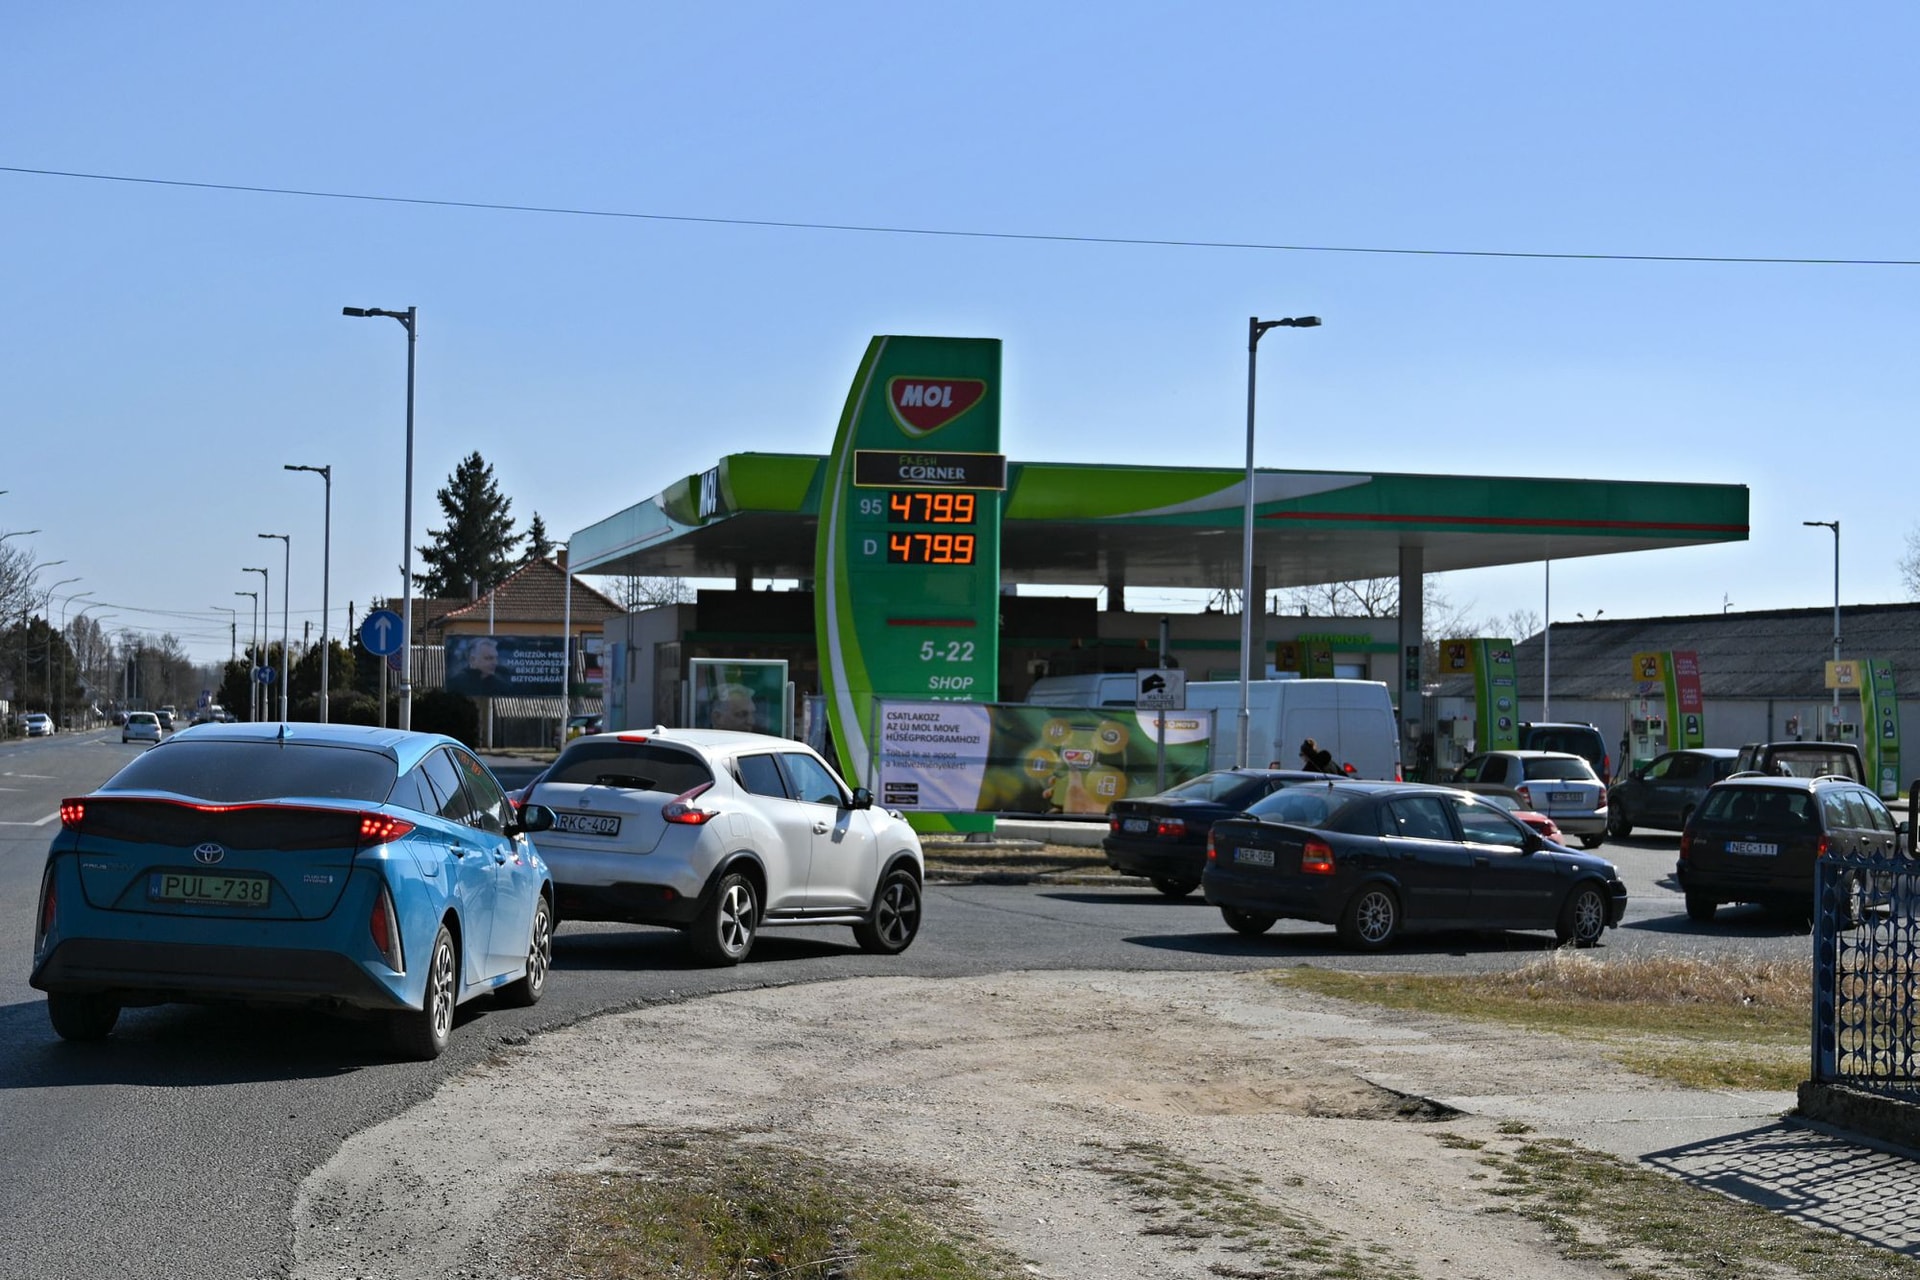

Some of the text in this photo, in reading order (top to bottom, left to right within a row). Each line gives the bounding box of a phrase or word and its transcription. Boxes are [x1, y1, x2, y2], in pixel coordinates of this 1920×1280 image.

[901, 385, 953, 408] MOL
[899, 455, 937, 465] FRESH
[899, 466, 965, 479] CORNER
[860, 499, 882, 514] 95
[863, 539, 877, 555] D
[920, 641, 975, 661] 5-22
[928, 676, 974, 690] SHOP
[886, 712, 940, 722] CSATLAKOZZ
[886, 722, 960, 733] AZ ÚJ MOL MOVE
[559, 815, 616, 832] RKC-402
[1731, 843, 1775, 853] NEC-111
[165, 877, 263, 900] PUL-738
